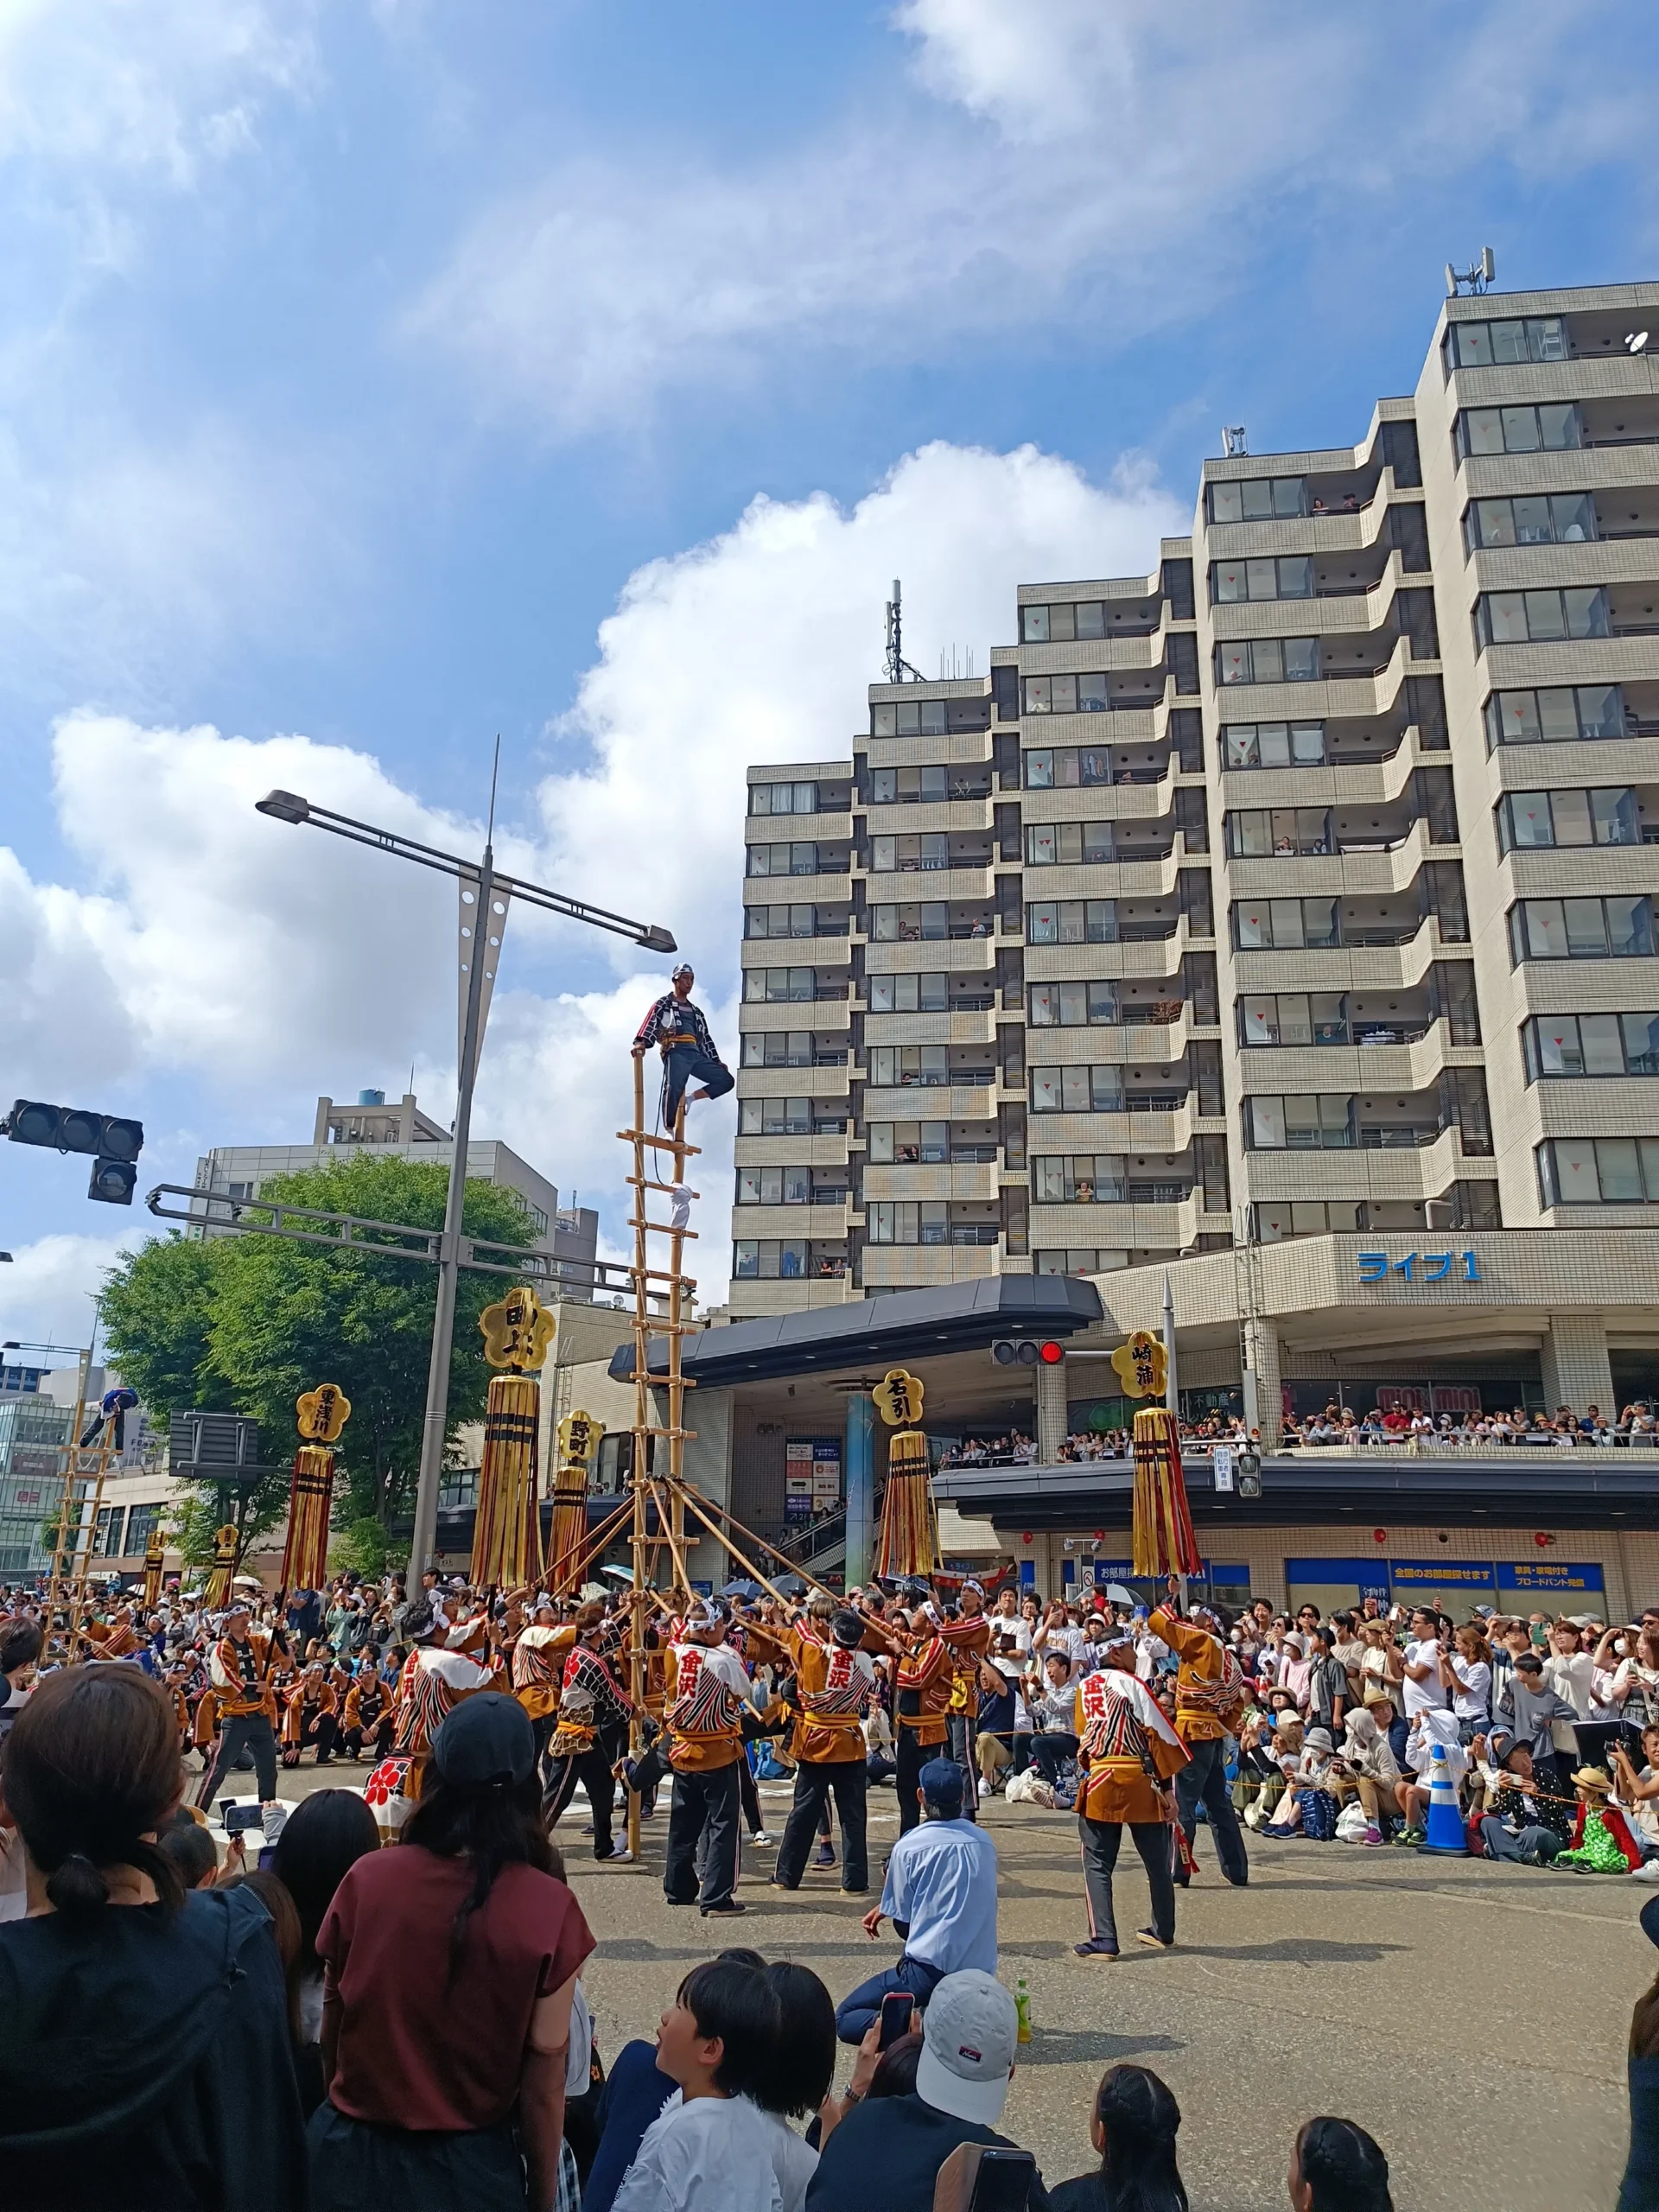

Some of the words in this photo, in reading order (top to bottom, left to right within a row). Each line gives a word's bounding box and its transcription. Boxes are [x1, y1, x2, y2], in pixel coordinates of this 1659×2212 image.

[1357, 1250, 1482, 1282] ライブ1
[1132, 1342, 1154, 1386] 崎浦
[312, 1388, 335, 1435] 東浅川
[887, 1376, 911, 1419] 石引
[1194, 1391, 1230, 1408] 不動産
[1378, 1387, 1421, 1412] mini
[1436, 1388, 1479, 1411] mini
[569, 1420, 590, 1456] 野町
[1395, 1567, 1491, 1580] 全国のお部屋探せます
[678, 1650, 702, 1699] 金沢
[828, 1649, 854, 1689] 金沢
[1084, 1674, 1107, 1719] 金沢
